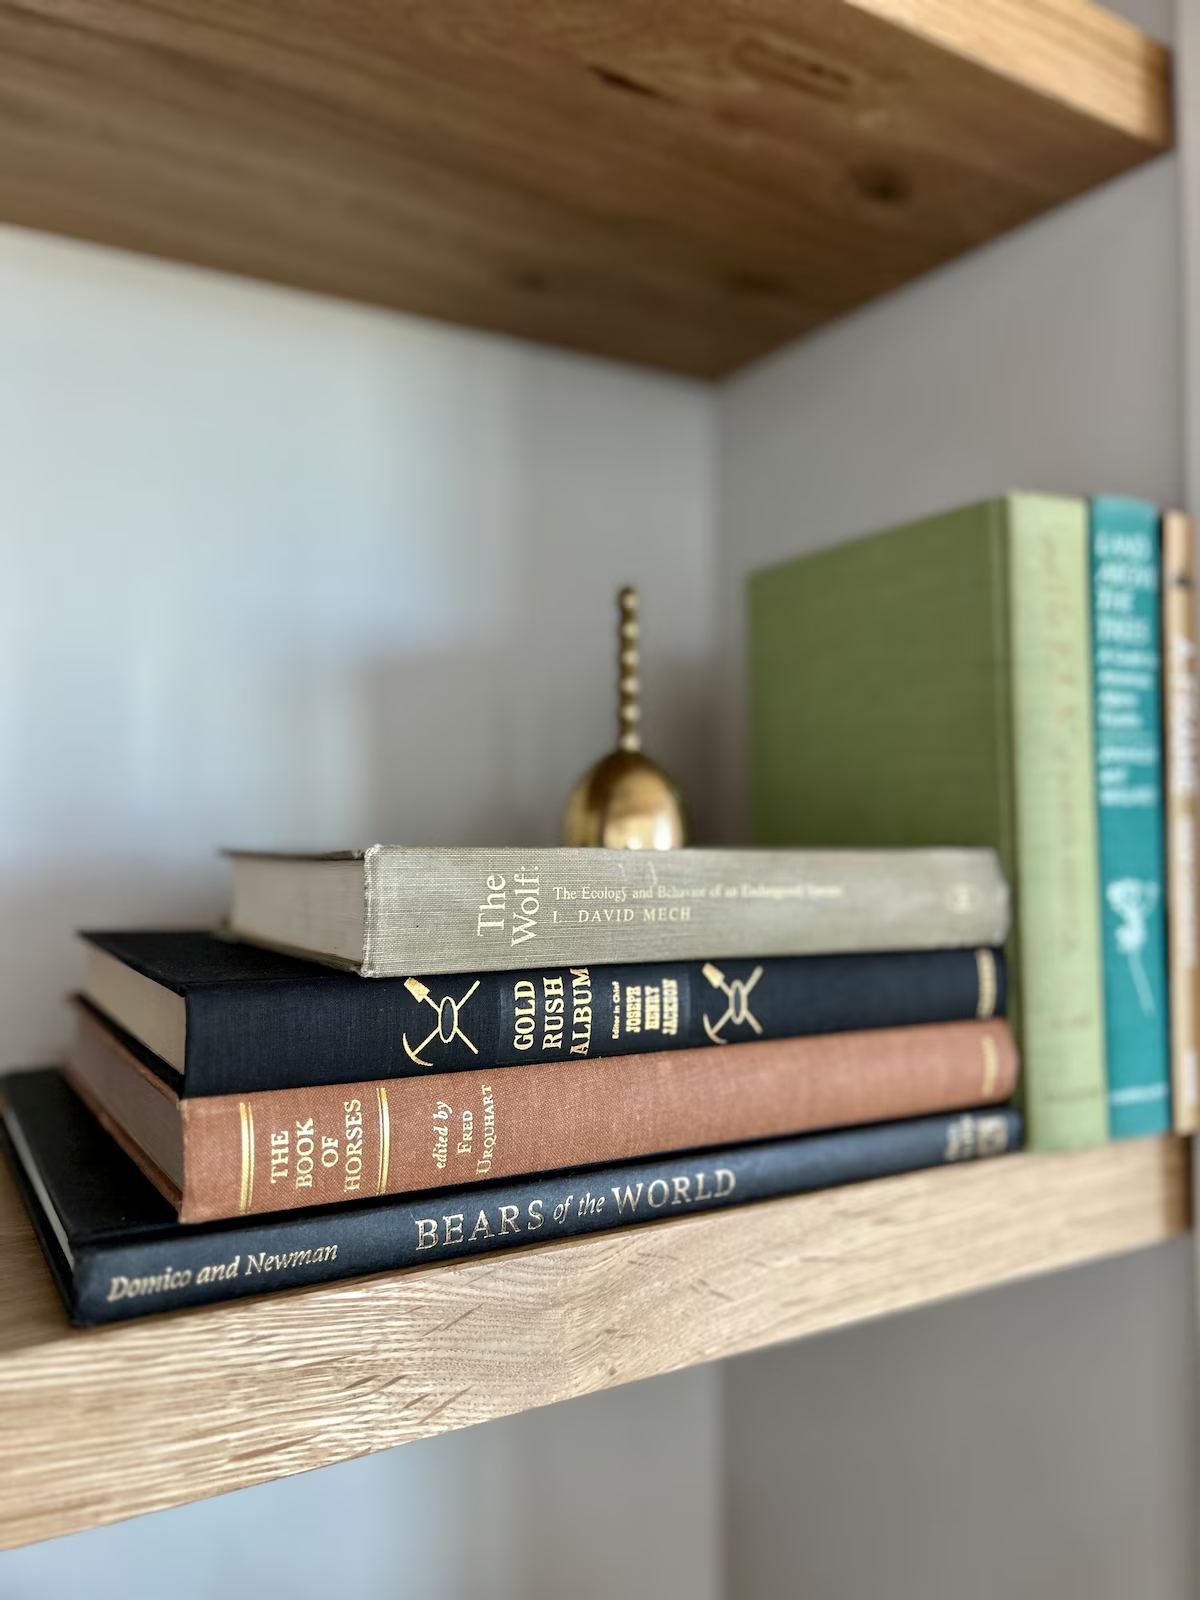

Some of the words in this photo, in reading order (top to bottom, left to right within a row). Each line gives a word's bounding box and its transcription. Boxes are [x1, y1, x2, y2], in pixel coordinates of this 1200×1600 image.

[477, 872, 506, 937] The
[511, 866, 540, 947] Wolf:
[553, 886, 577, 900] The
[581, 886, 627, 902] Ecology
[632, 884, 653, 899] and
[658, 884, 705, 899] Behav
[578, 908, 634, 923] DAVID
[643, 906, 691, 921] MECH
[513, 980, 536, 1051] GOLD
[542, 976, 564, 1050] RUSH
[569, 968, 592, 1056] ALBUM
[611, 981, 620, 1003] Chief
[625, 985, 642, 1033] JOSEPH
[611, 1015, 620, 1039] Editor
[432, 1100, 453, 1120] by
[457, 1110, 473, 1154] FRED
[476, 1084, 497, 1175] URQUHART
[271, 1130, 289, 1184] THE
[296, 1117, 314, 1189] BOOK
[321, 1135, 339, 1168] OF
[343, 1099, 363, 1193] HORSES
[432, 1125, 449, 1169] edited
[415, 1199, 544, 1251] BEARS
[553, 1195, 573, 1224] of
[578, 1192, 605, 1216] the
[611, 1168, 737, 1215] WORLD
[107, 1265, 191, 1302] Domico
[196, 1255, 241, 1285] and
[245, 1244, 338, 1276] Newman
